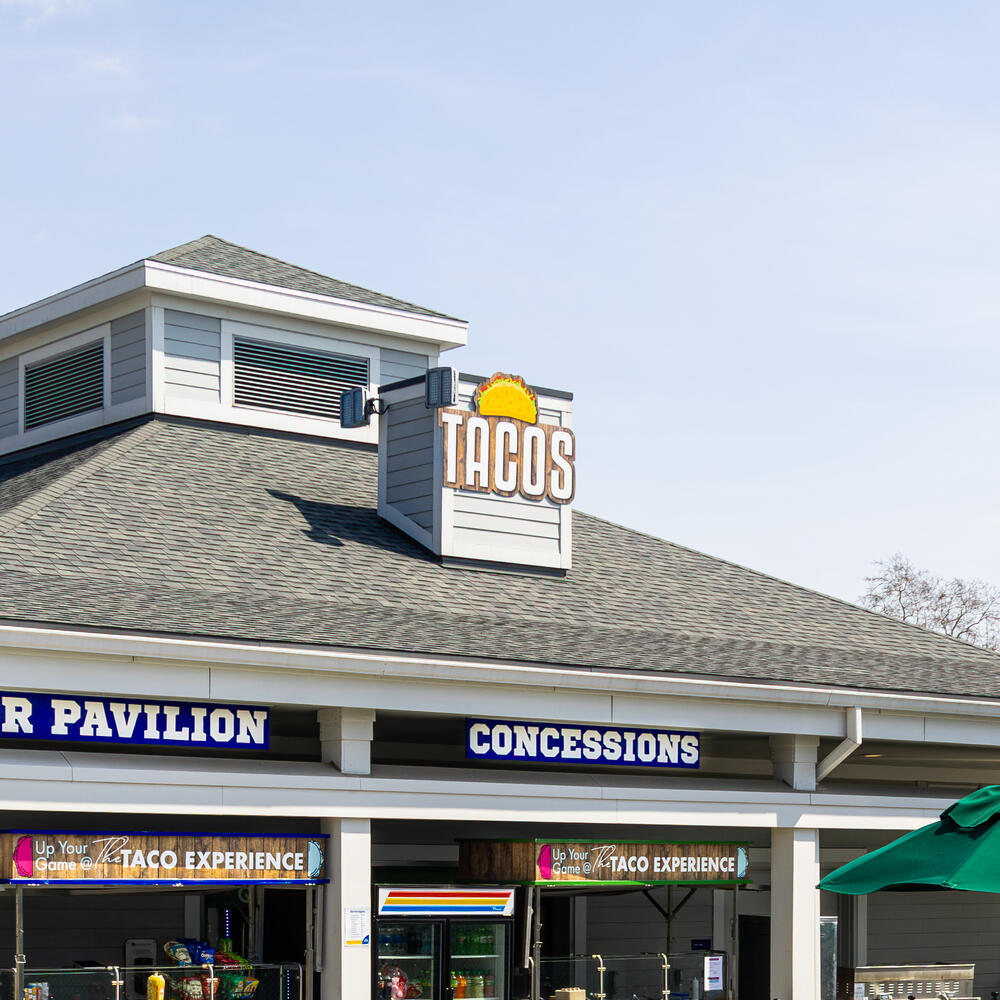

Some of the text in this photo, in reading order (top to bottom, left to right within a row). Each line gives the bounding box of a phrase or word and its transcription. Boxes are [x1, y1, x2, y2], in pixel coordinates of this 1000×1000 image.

[442, 412, 573, 500] TACOS
[51, 699, 267, 744] PAVILION
[469, 723, 699, 764] CONCESSIONS
[35, 841, 88, 858] Up Your
[35, 856, 93, 871] Game @
[92, 836, 304, 870] The TACO EXPERIENCE
[552, 848, 589, 864] Up Your
[591, 845, 735, 873] The TACO EXPERIENCE
[552, 862, 592, 874] Game @
